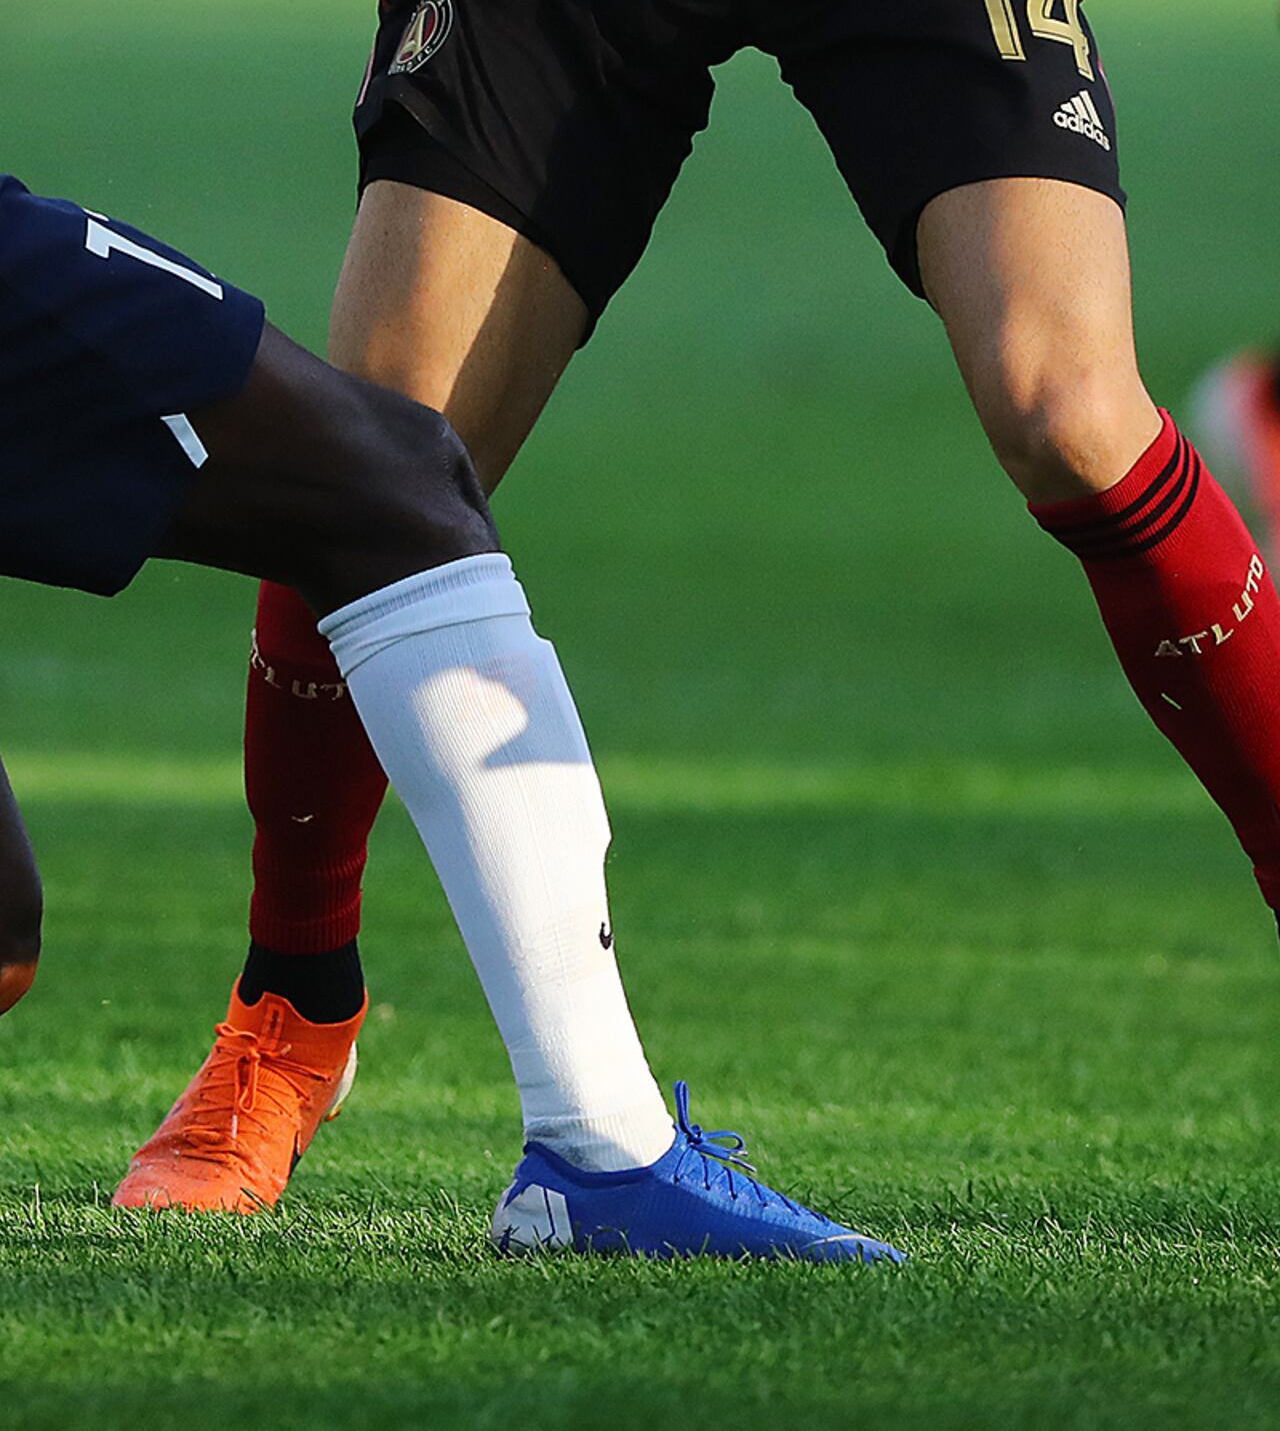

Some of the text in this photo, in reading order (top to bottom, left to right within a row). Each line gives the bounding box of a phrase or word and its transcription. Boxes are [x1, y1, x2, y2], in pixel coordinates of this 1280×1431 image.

[1053, 111, 1111, 152] adidas
[1154, 554, 1264, 658] ATL UTD
